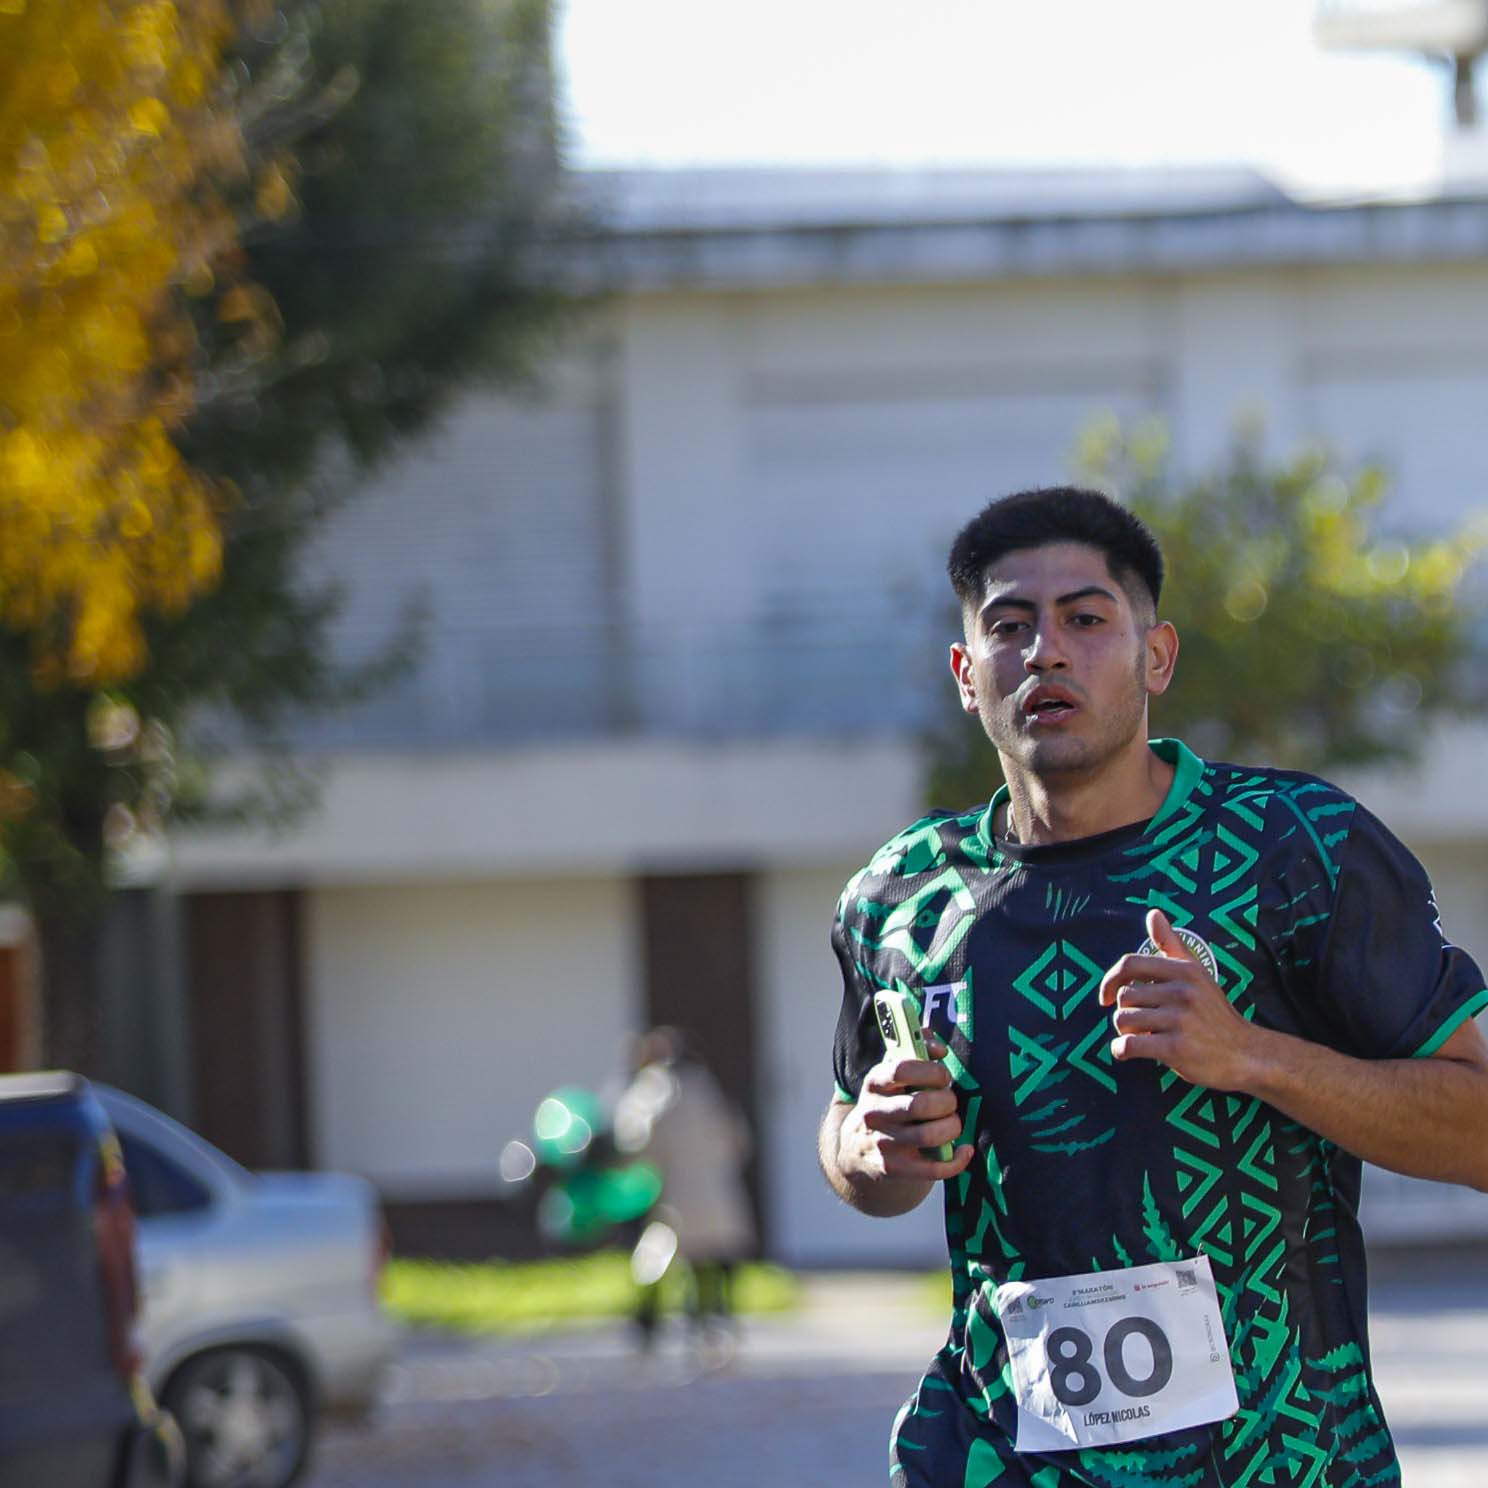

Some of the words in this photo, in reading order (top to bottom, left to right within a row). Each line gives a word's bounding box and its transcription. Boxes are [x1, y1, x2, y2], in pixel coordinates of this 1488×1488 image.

[1046, 1316, 1173, 1407] 80
[1083, 1411, 1112, 1427] LÓPEZ
[1111, 1404, 1151, 1423] NICOLAS
